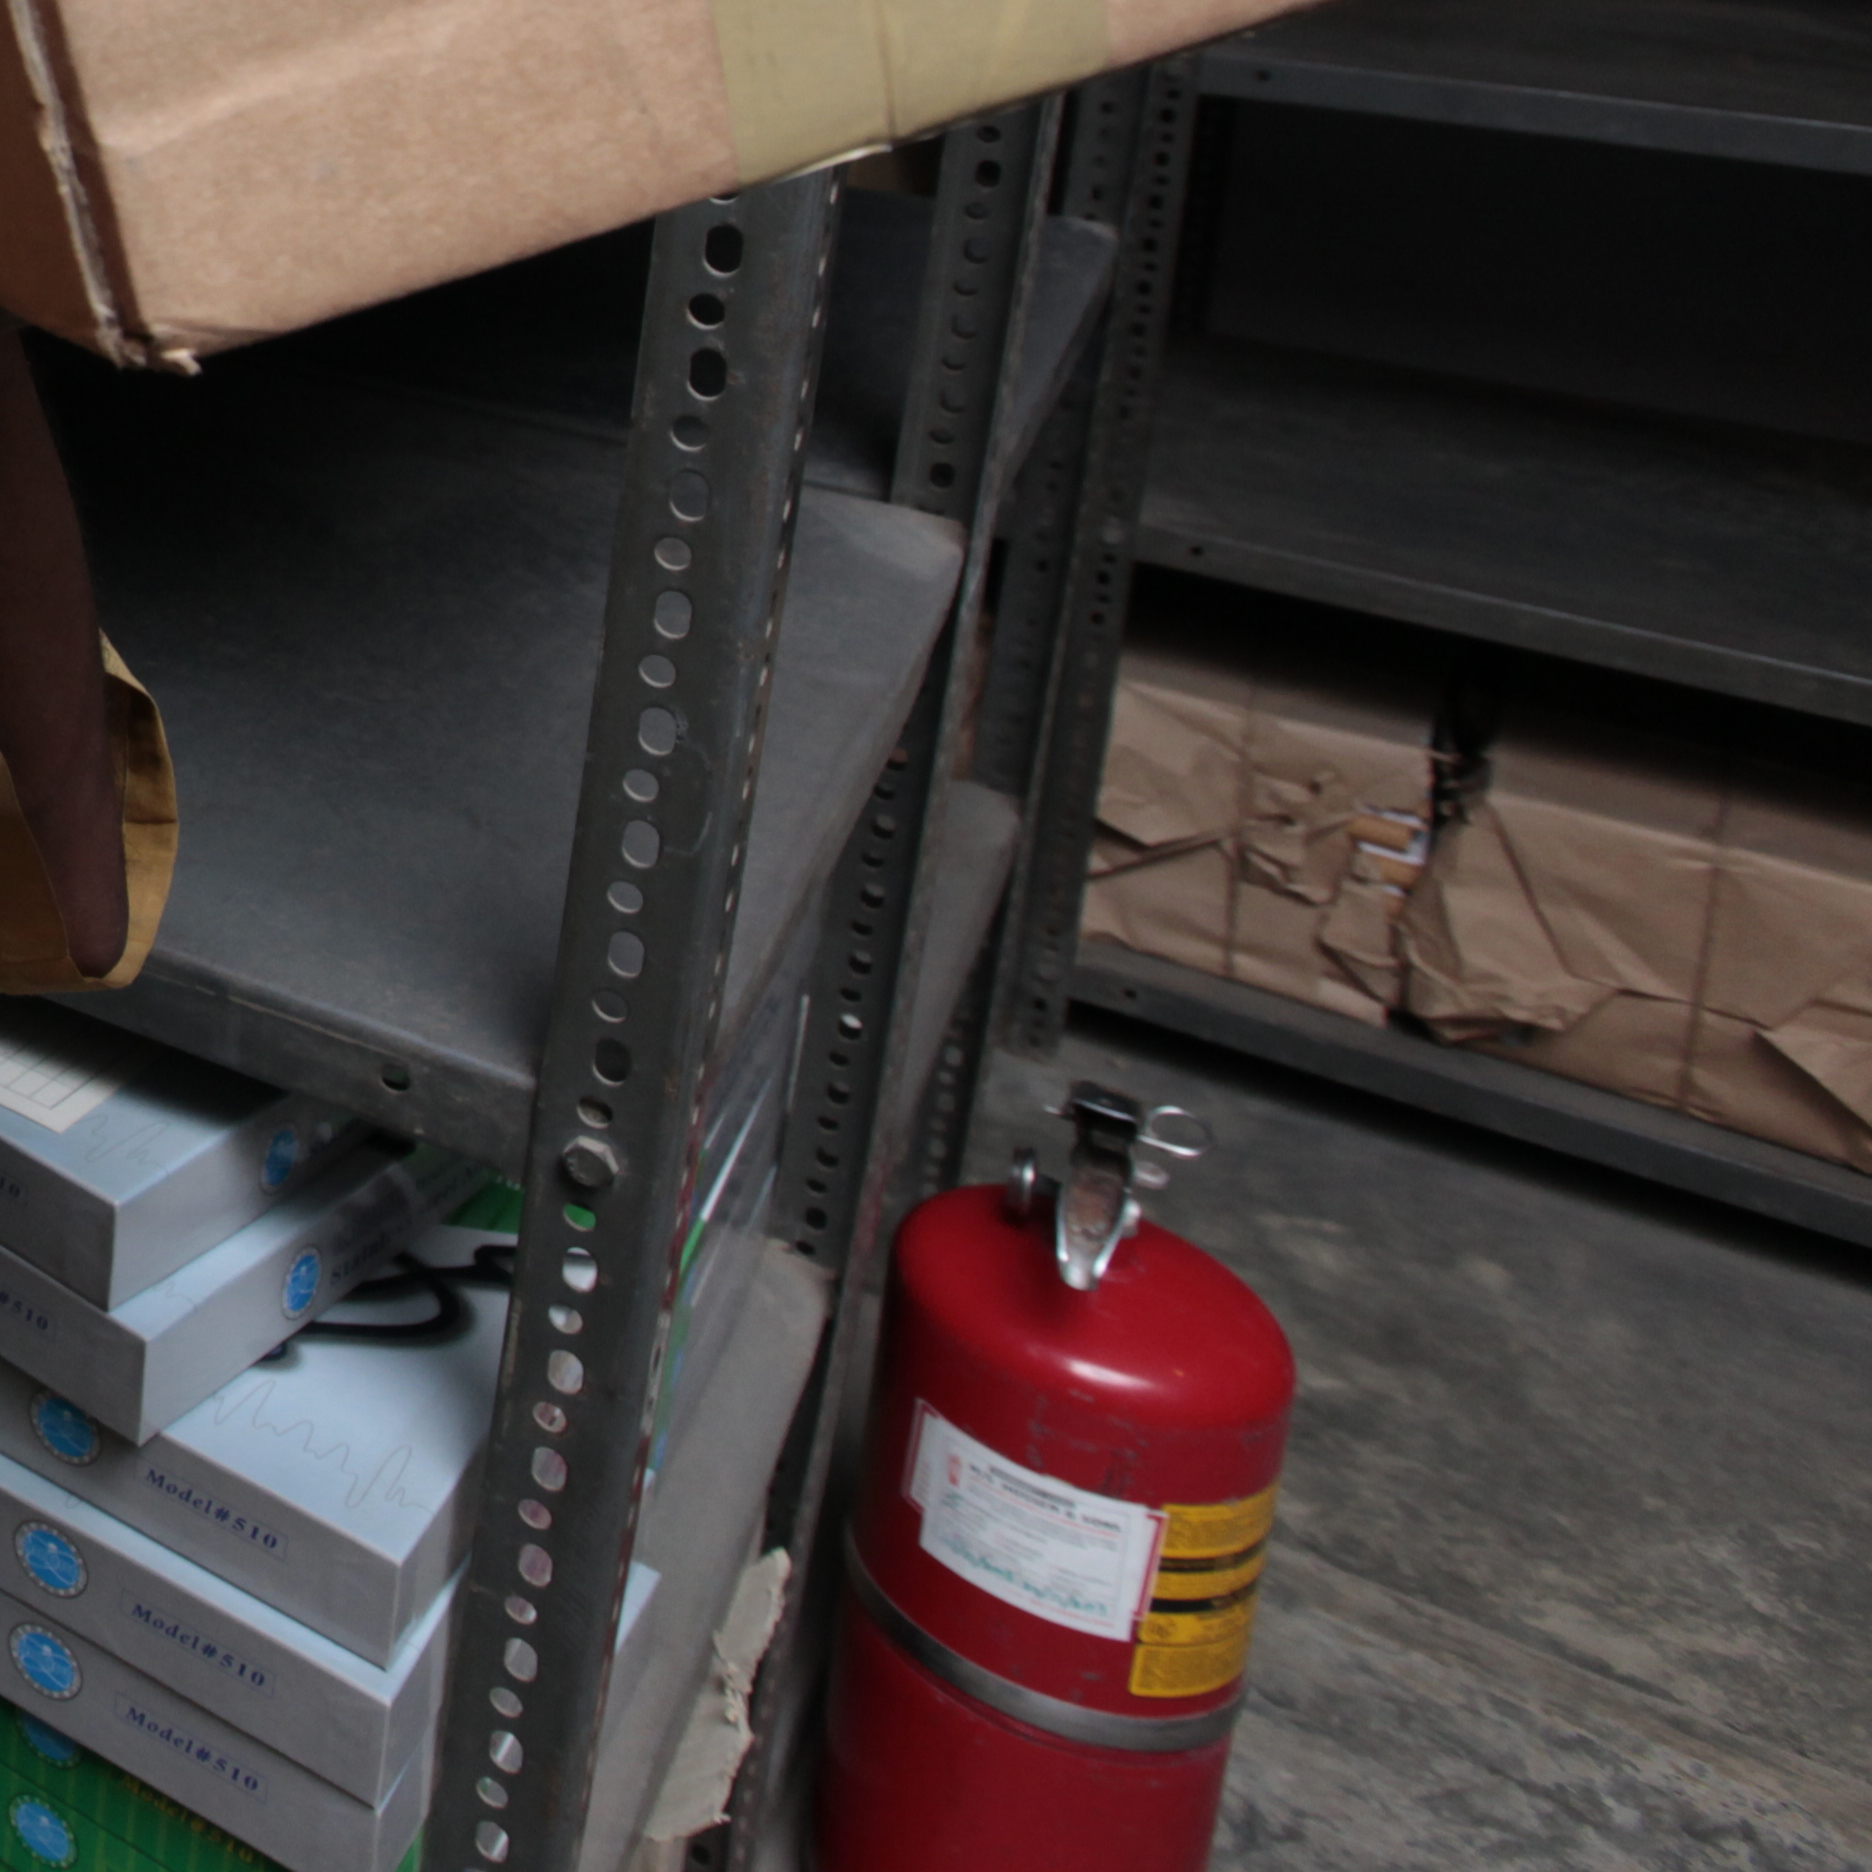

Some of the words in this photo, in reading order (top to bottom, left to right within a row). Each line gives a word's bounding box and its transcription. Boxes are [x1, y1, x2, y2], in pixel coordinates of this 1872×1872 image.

[145, 1468, 278, 1551] Model#510
[131, 1603, 266, 1688] Model#510
[126, 1706, 259, 1793] Model#510
